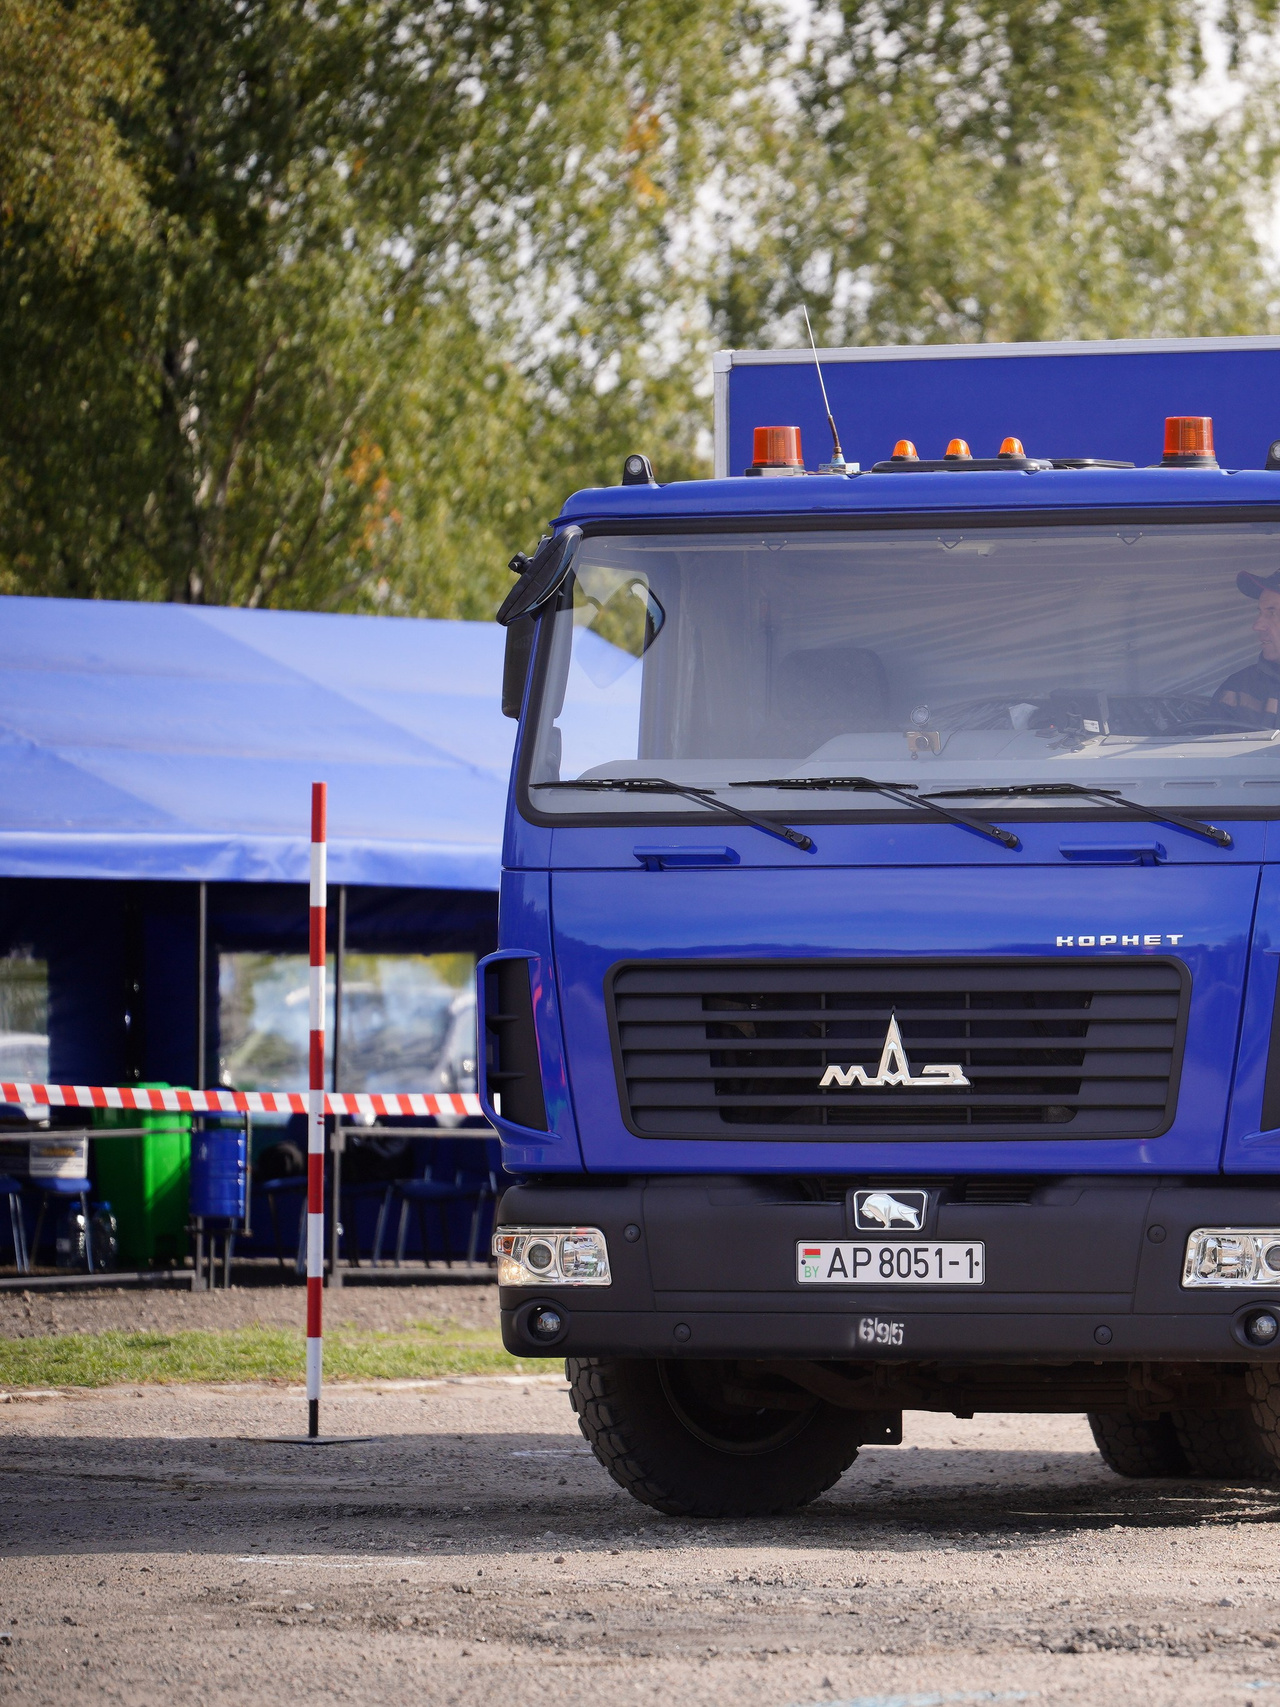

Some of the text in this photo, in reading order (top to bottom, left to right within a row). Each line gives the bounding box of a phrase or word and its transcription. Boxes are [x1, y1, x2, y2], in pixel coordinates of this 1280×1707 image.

[1056, 934, 1184, 947] КОРНЕТ
[819, 1012, 971, 1087] МАЗ
[804, 1265, 820, 1278] BY
[858, 1317, 905, 1345] 695
